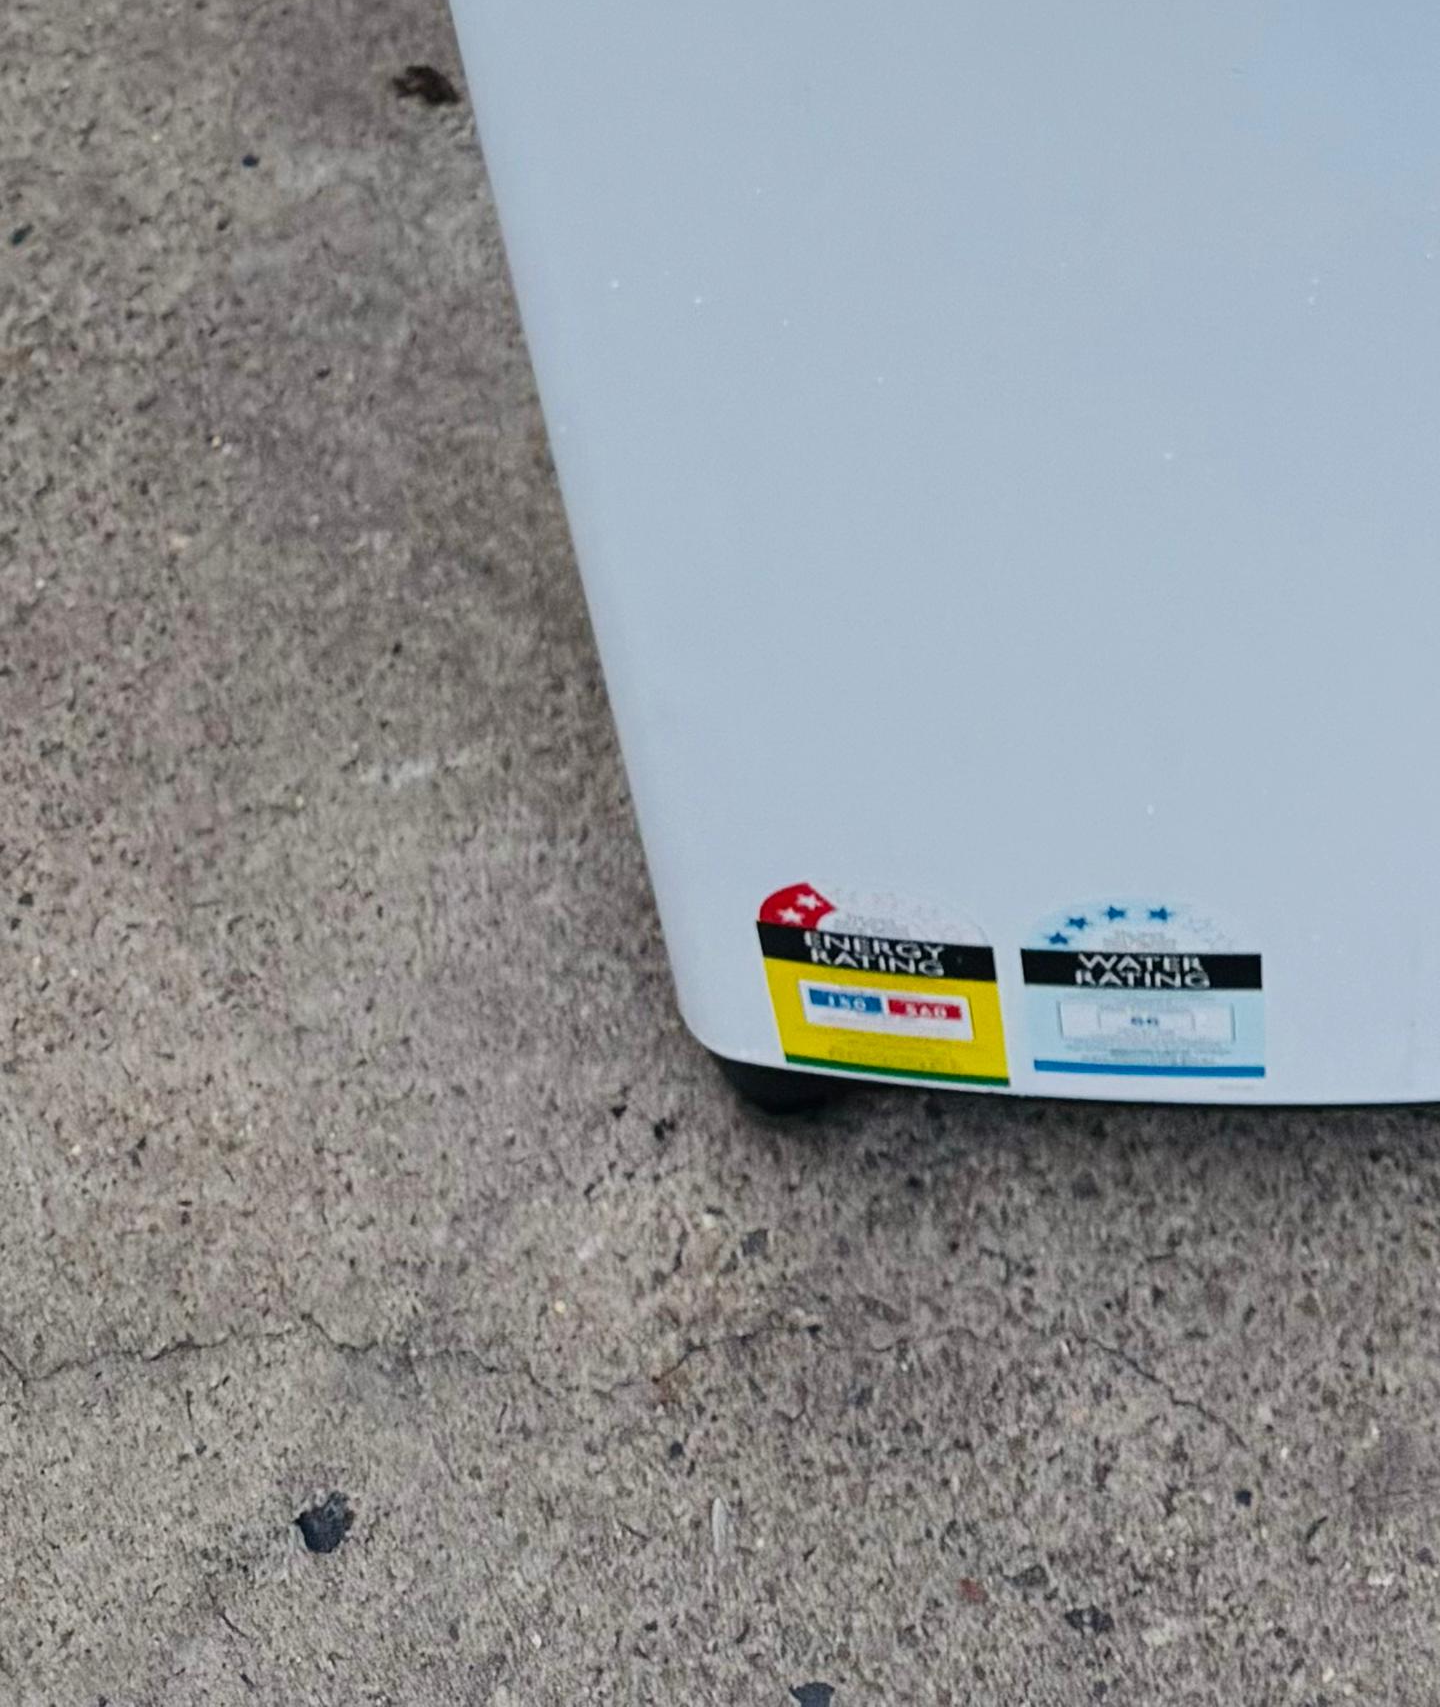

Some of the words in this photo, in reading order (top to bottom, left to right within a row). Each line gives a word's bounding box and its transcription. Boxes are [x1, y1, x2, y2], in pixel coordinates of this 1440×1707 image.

[804, 931, 945, 961] ENERGY
[810, 949, 944, 976] RATING
[1078, 954, 1202, 972] WATER
[1075, 971, 1210, 988] RATING
